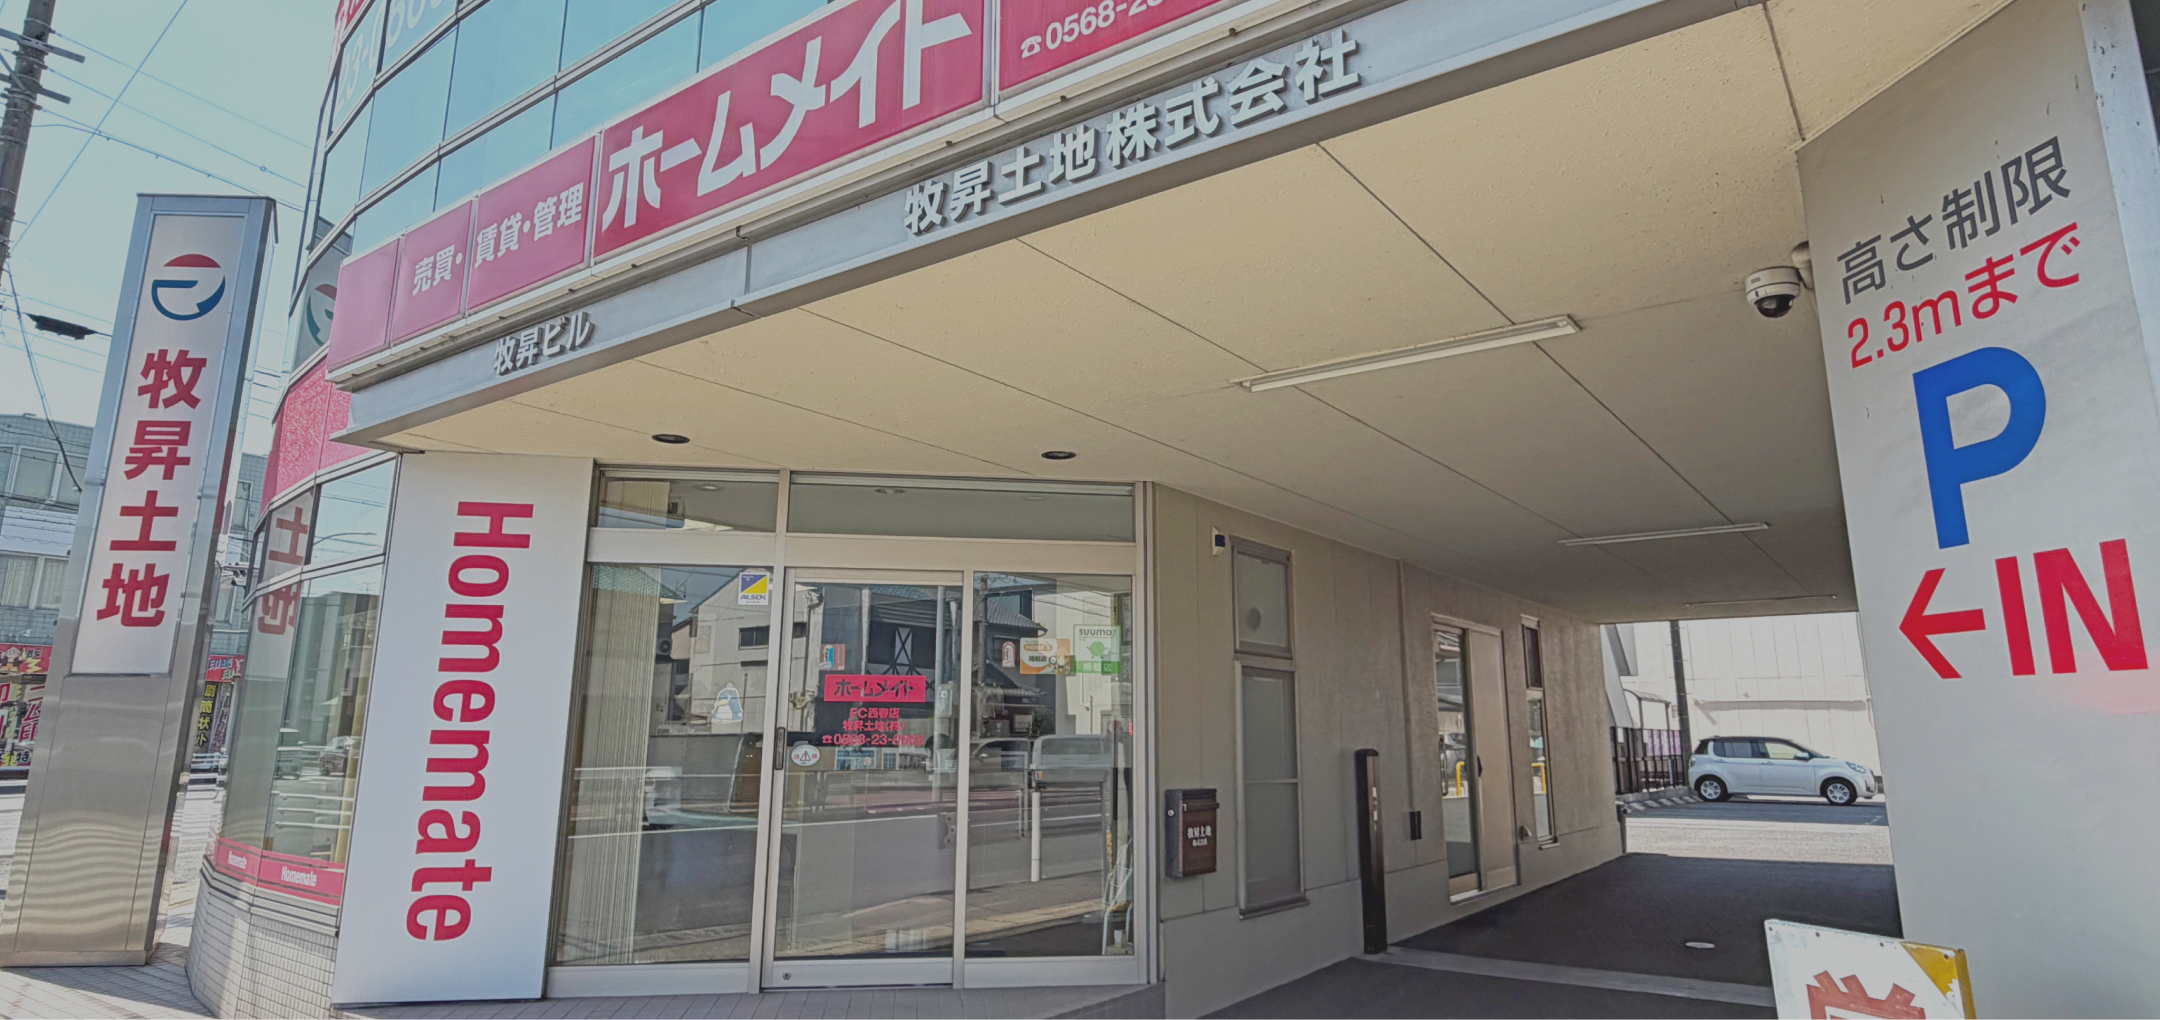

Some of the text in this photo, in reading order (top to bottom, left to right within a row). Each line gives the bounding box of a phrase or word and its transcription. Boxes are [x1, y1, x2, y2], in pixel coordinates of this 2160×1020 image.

[1045, 0, 1163, 50] 0568-2
[602, 0, 972, 232] ホームメイト
[904, 28, 1360, 236] 牧昇土地株式会社
[1837, 136, 2071, 305] 高さ制限
[1847, 221, 2081, 368] 2.3mまで
[493, 310, 594, 376] 牧昇ビル
[96, 348, 208, 628] 牧昇土地
[1912, 346, 2046, 549] P
[1995, 538, 2149, 676] IN
[406, 502, 534, 941] Homemate
[834, 678, 915, 698] ホームメイト
[281, 866, 318, 887] Homemate
